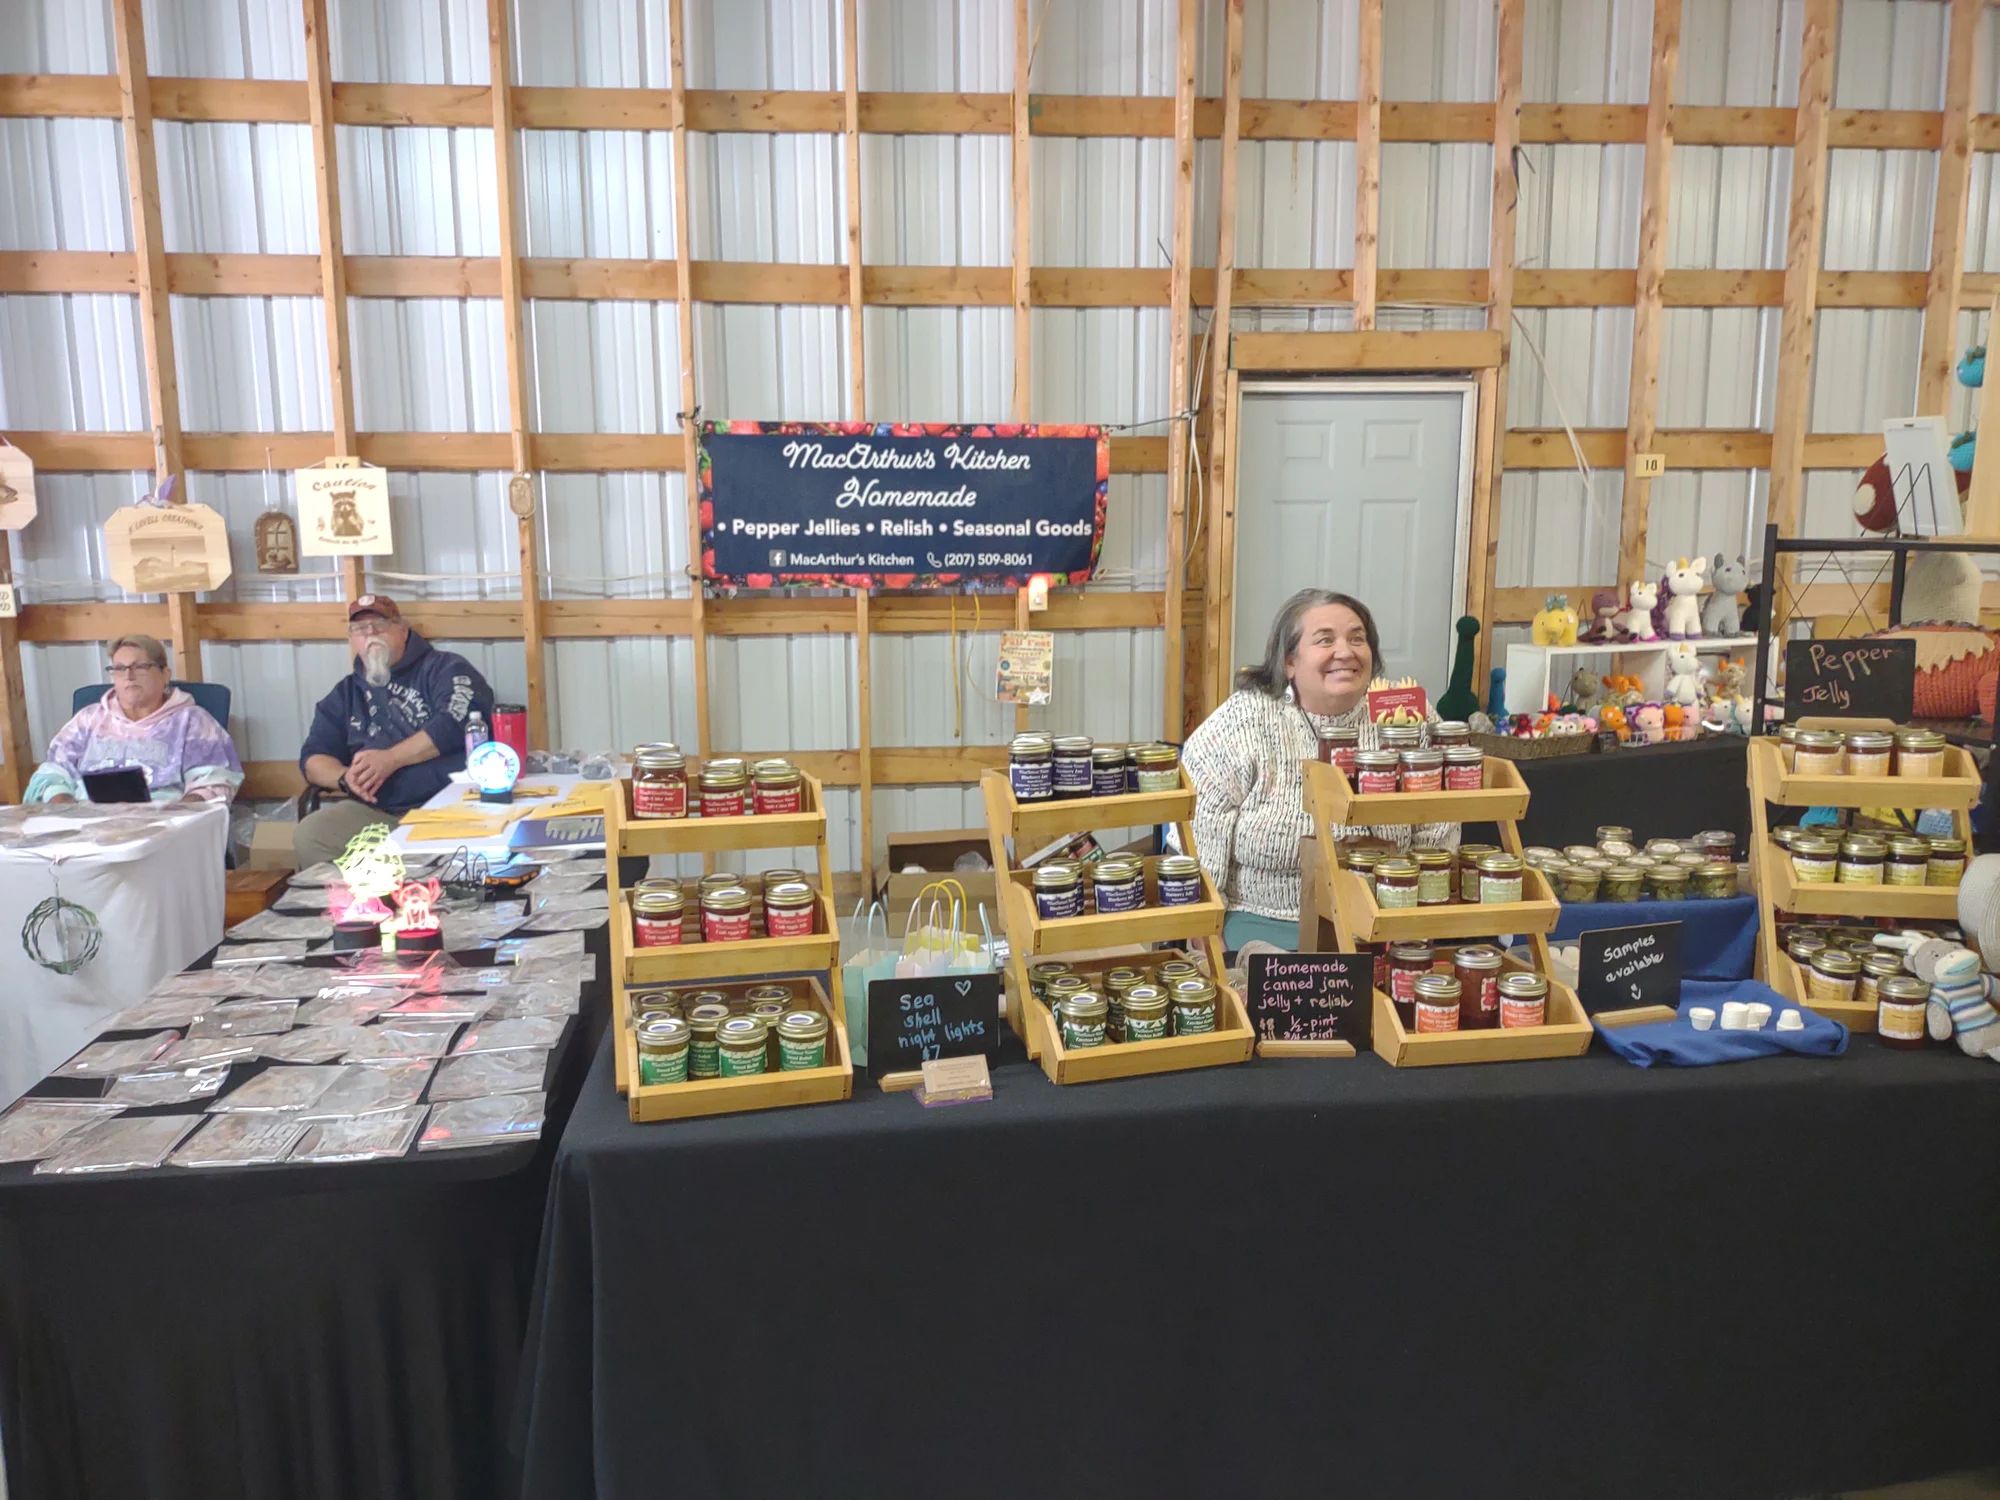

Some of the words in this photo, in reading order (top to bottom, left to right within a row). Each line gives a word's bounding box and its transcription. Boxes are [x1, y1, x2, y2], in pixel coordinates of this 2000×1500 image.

[782, 441, 936, 469] MacArthur's
[944, 441, 1031, 469] Kitchen
[312, 478, 377, 492] Caution
[836, 475, 977, 508] Homemade
[733, 519, 800, 539] Pepper
[804, 519, 860, 537] Jellies
[881, 520, 933, 537] Relish
[953, 520, 1031, 537] Seasonal
[1035, 520, 1092, 538] Goods
[790, 552, 865, 566] MacArthur's
[868, 552, 914, 566] Kitchen
[944, 552, 975, 568] (207)
[977, 553, 1033, 566] 509-8061
[1809, 643, 1893, 681] Pepper
[1802, 680, 1850, 709] Jelly
[1603, 934, 1655, 963] Samples
[1265, 957, 1349, 977] Homemade
[1605, 953, 1664, 983] available
[1263, 975, 1313, 991] canned
[1319, 976, 1354, 993] jam,
[899, 994, 935, 1011] Sea
[1258, 993, 1290, 1013] jelly
[1294, 995, 1304, 1006] +
[1310, 993, 1353, 1010] relish
[904, 1006, 941, 1028] shell
[898, 1028, 936, 1049] night
[944, 1020, 985, 1041] lights
